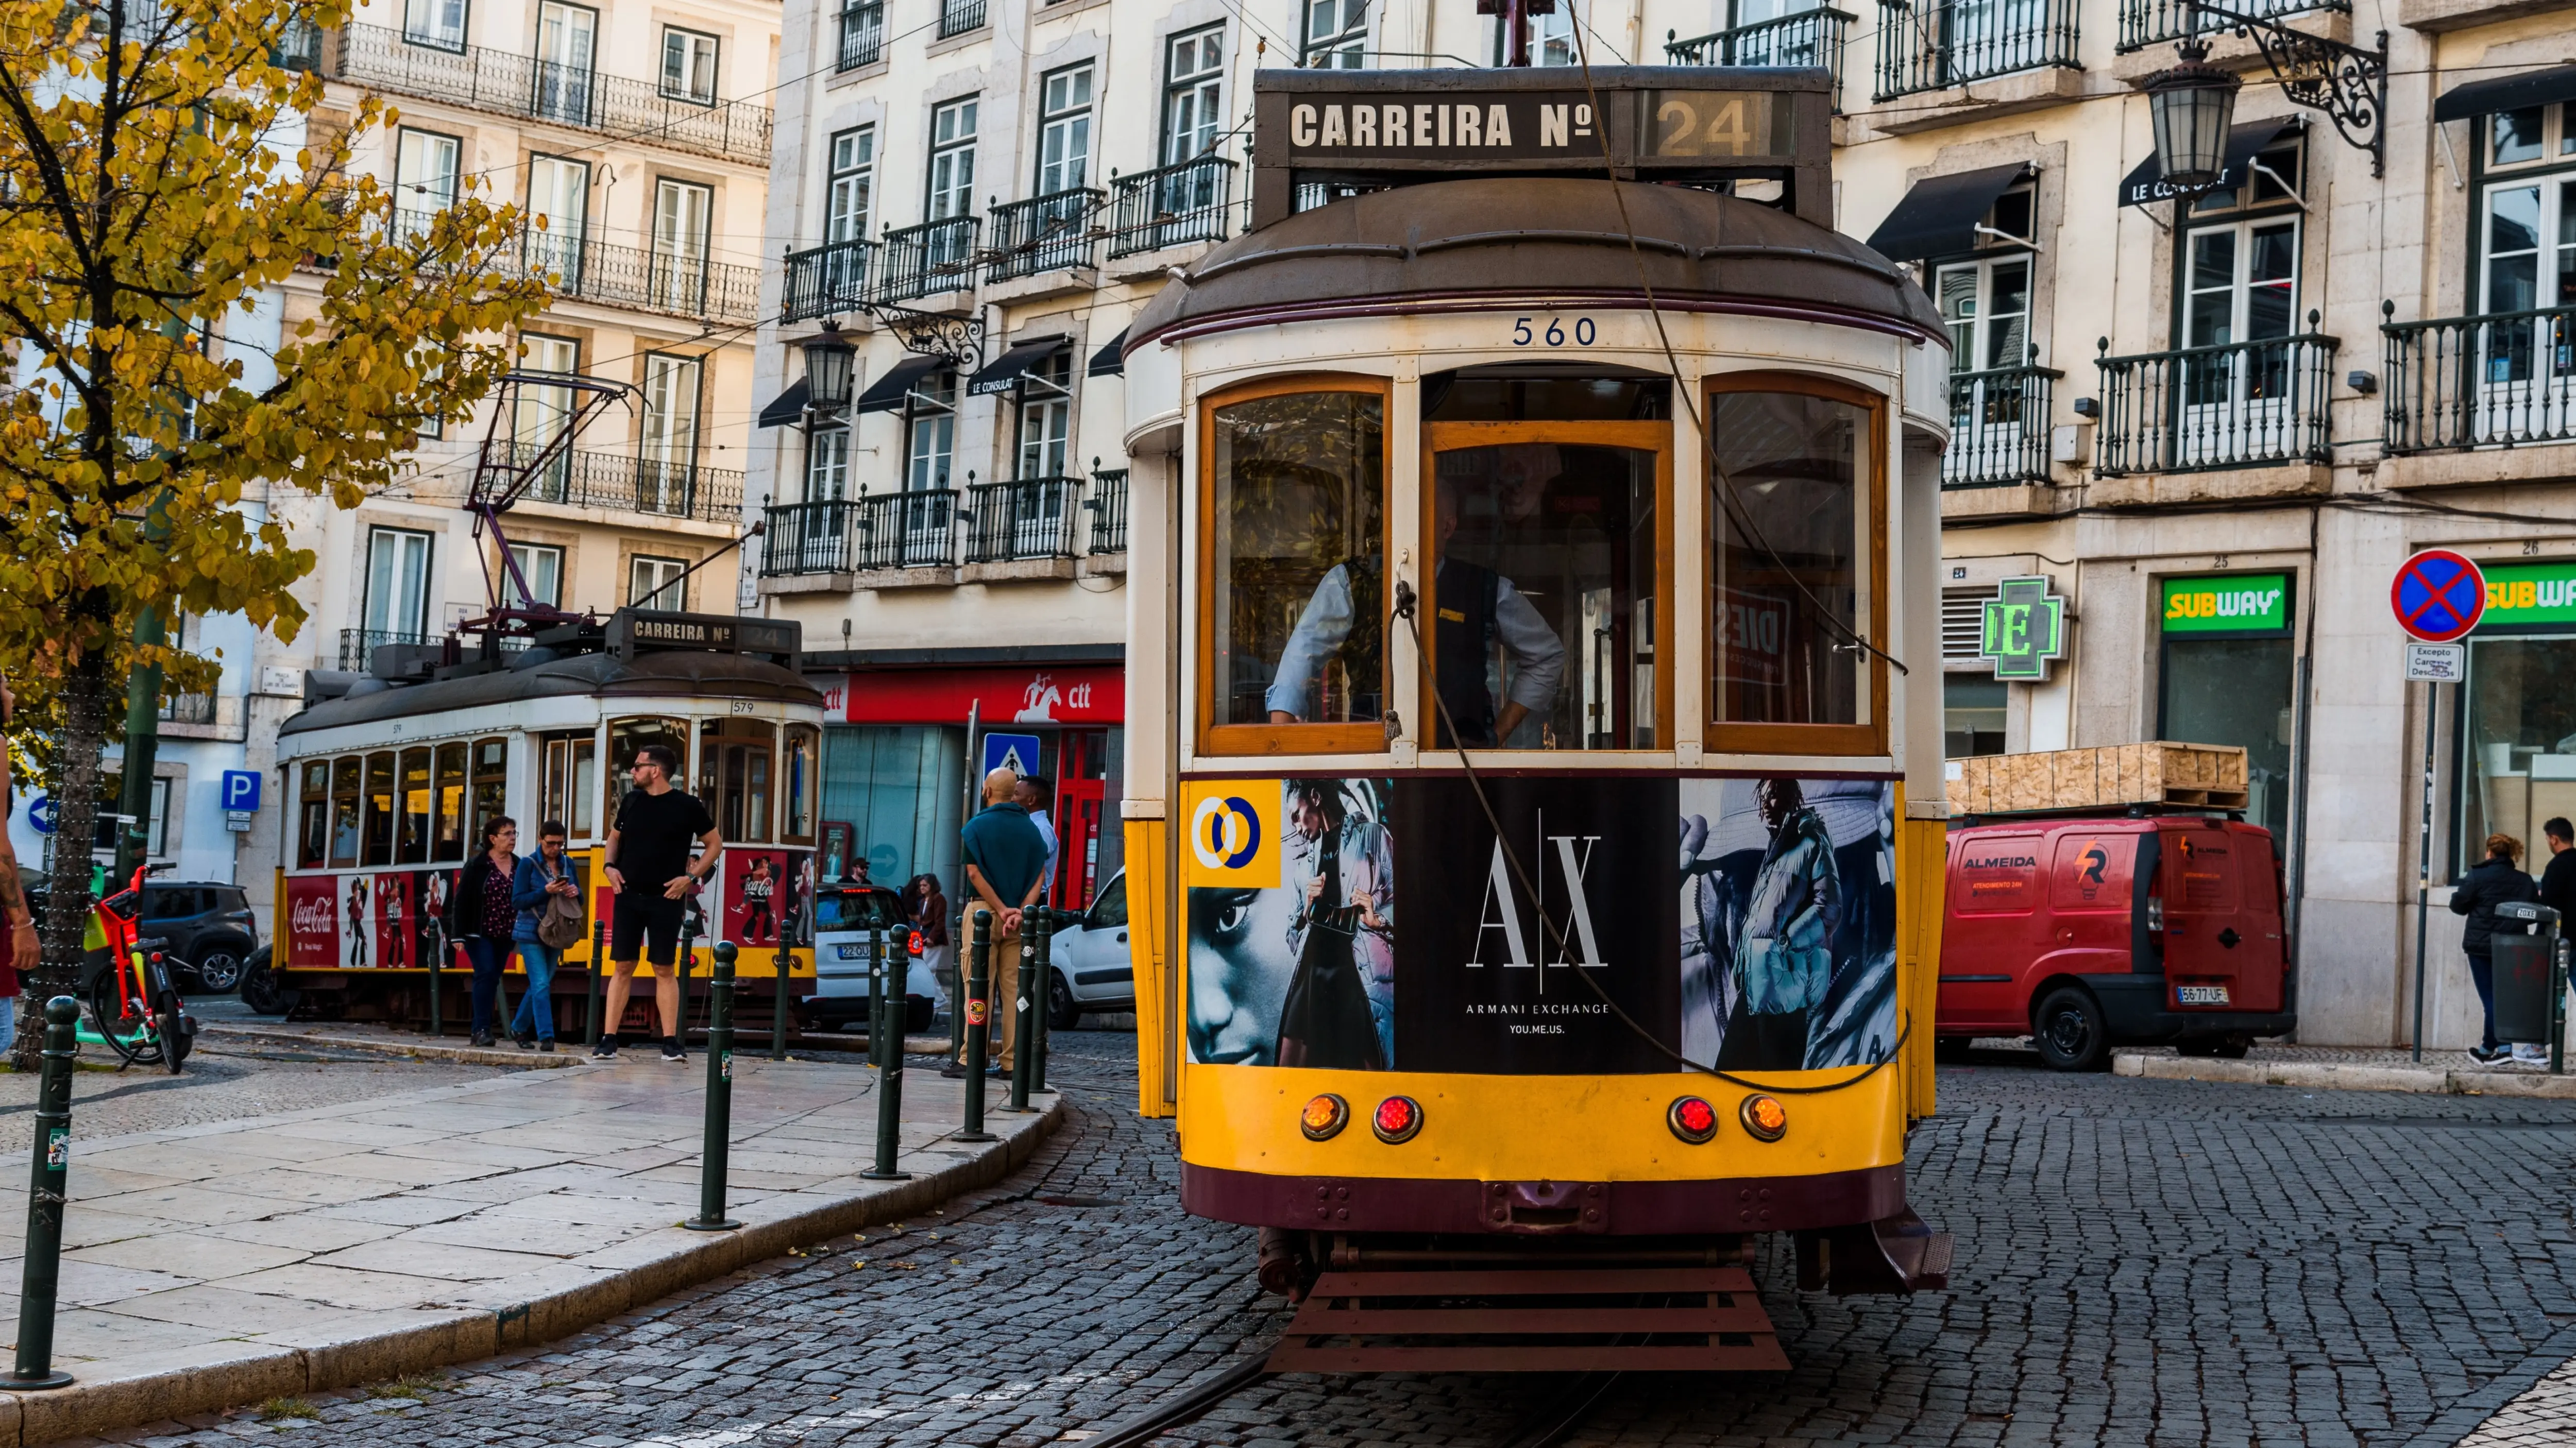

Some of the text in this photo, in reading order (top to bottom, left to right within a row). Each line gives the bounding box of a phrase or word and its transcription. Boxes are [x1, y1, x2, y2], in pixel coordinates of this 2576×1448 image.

[1291, 103, 1512, 147] CARREIRA
[1657, 100, 1750, 156] 24
[2132, 184, 2148, 201] LE
[1513, 317, 1596, 346] 560
[973, 378, 1013, 394] LE CONSULAT
[2522, 541, 2538, 555] 26
[2214, 555, 2228, 568] 25
[1954, 569, 1964, 578] 24
[2165, 588, 2281, 620] SUBWAY
[634, 621, 705, 641] CARREIRA
[2417, 648, 2451, 657] Excepto
[823, 686, 842, 710] ctt
[1069, 683, 1091, 709] ctt
[734, 702, 753, 713] 579
[393, 724, 401, 734] 579
[230, 775, 251, 805] P
[1964, 857, 2037, 868] ALMEIDA
[1466, 1004, 1608, 1014] ARMANI EXCHANGE
[1510, 1025, 1565, 1034] YOU.ME.US.
